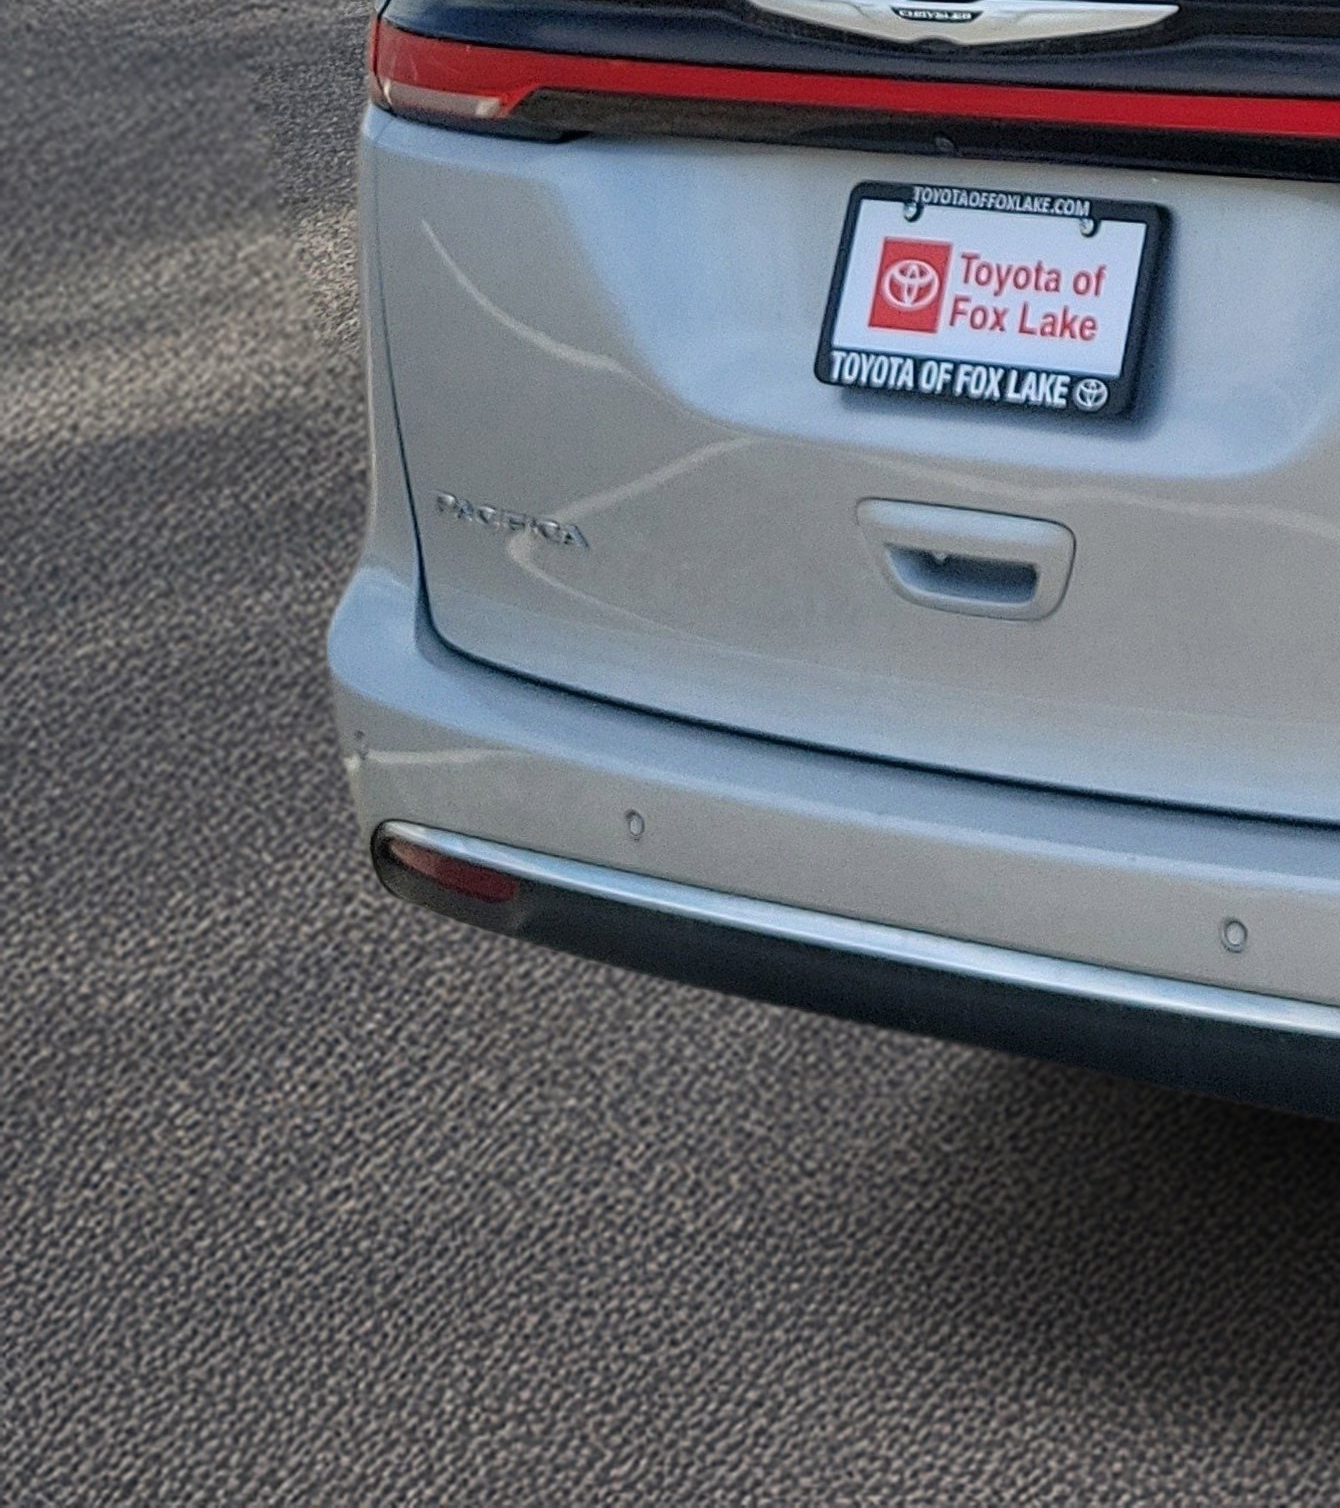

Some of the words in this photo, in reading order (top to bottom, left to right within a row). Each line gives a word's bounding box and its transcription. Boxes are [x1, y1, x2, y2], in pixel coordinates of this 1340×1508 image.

[914, 187, 1091, 217] TOYOTAOFFOXLAKE.COM
[961, 252, 1061, 296] Toyota
[1072, 264, 1107, 297] of
[950, 296, 1008, 333] Fox
[1017, 303, 1099, 342] Lake
[830, 351, 915, 390] TOYOTA
[921, 360, 953, 393] OF
[955, 365, 1005, 400] FOX
[1007, 370, 1070, 409] LAKE
